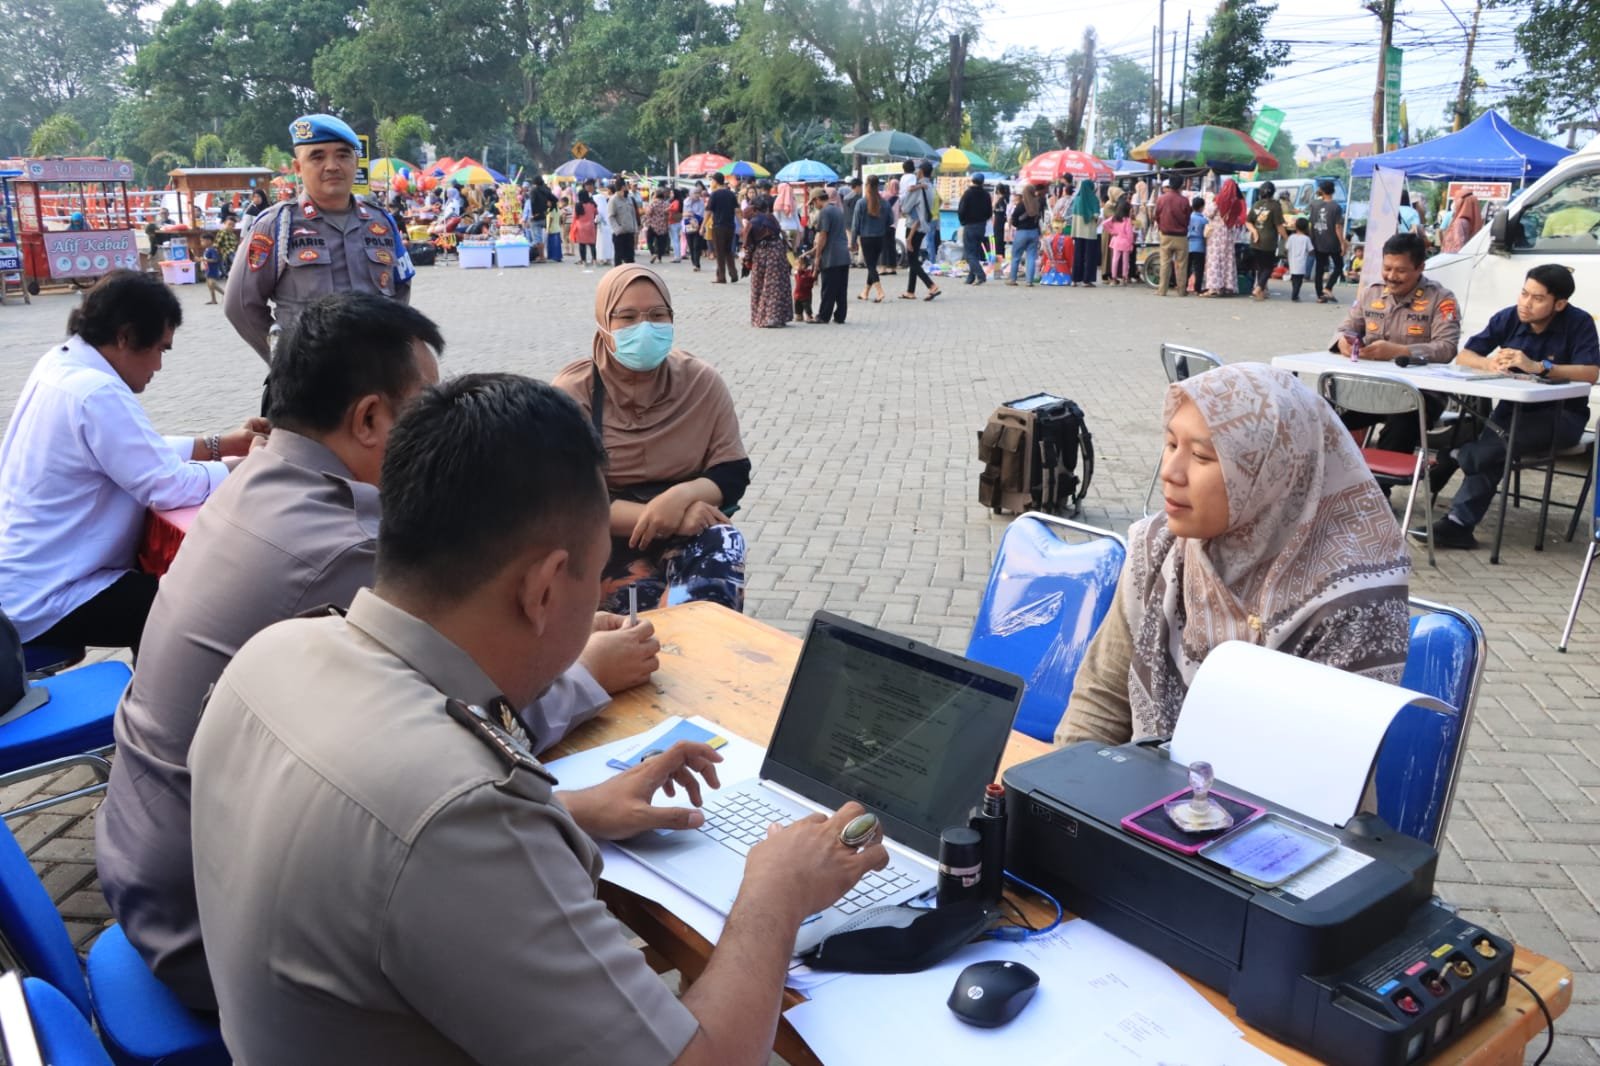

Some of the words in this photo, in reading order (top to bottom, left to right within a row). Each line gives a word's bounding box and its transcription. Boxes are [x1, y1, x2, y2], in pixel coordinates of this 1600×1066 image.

[51, 237, 80, 256] Alif
[84, 236, 129, 252] Kebab
[291, 237, 325, 249] HARIS
[364, 237, 394, 249] POLRI
[1406, 313, 1429, 322] POLRI
